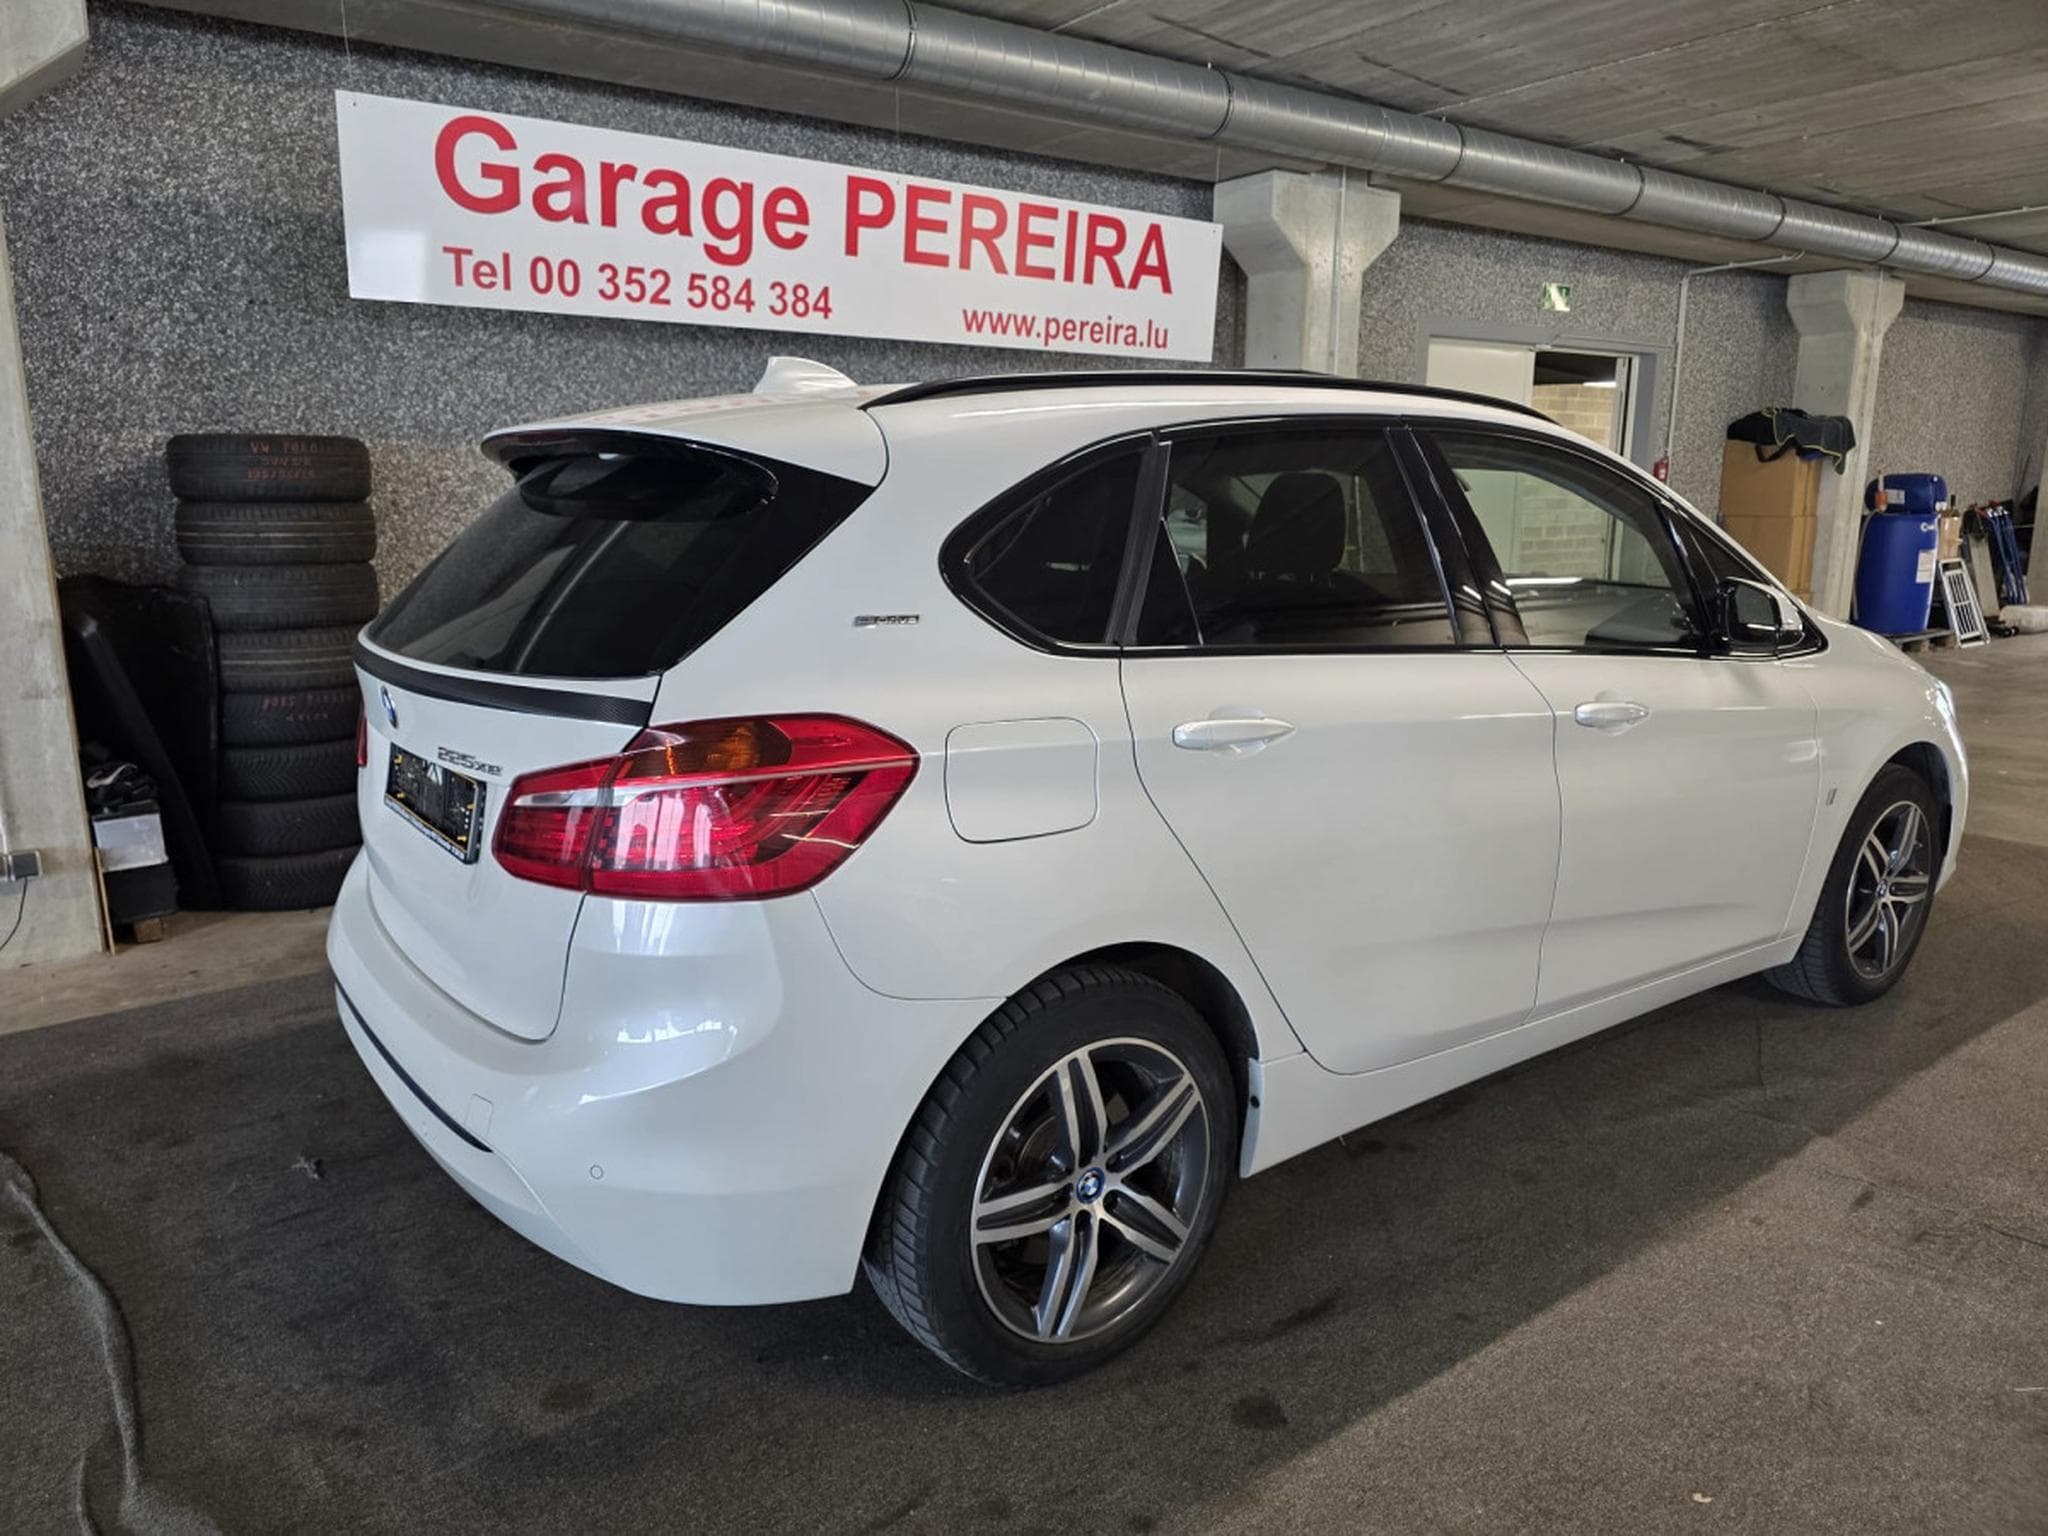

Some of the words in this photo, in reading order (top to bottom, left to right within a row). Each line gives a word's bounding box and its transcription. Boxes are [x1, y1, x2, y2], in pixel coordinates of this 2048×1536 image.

[433, 114, 812, 268] Garage
[844, 174, 1174, 297] PEREIRA
[442, 244, 513, 290] Tel
[528, 255, 582, 299] 00
[597, 262, 672, 307] 352
[687, 271, 756, 314] 584
[769, 280, 834, 320] 384
[962, 308, 1170, 350] www.pereira.lu
